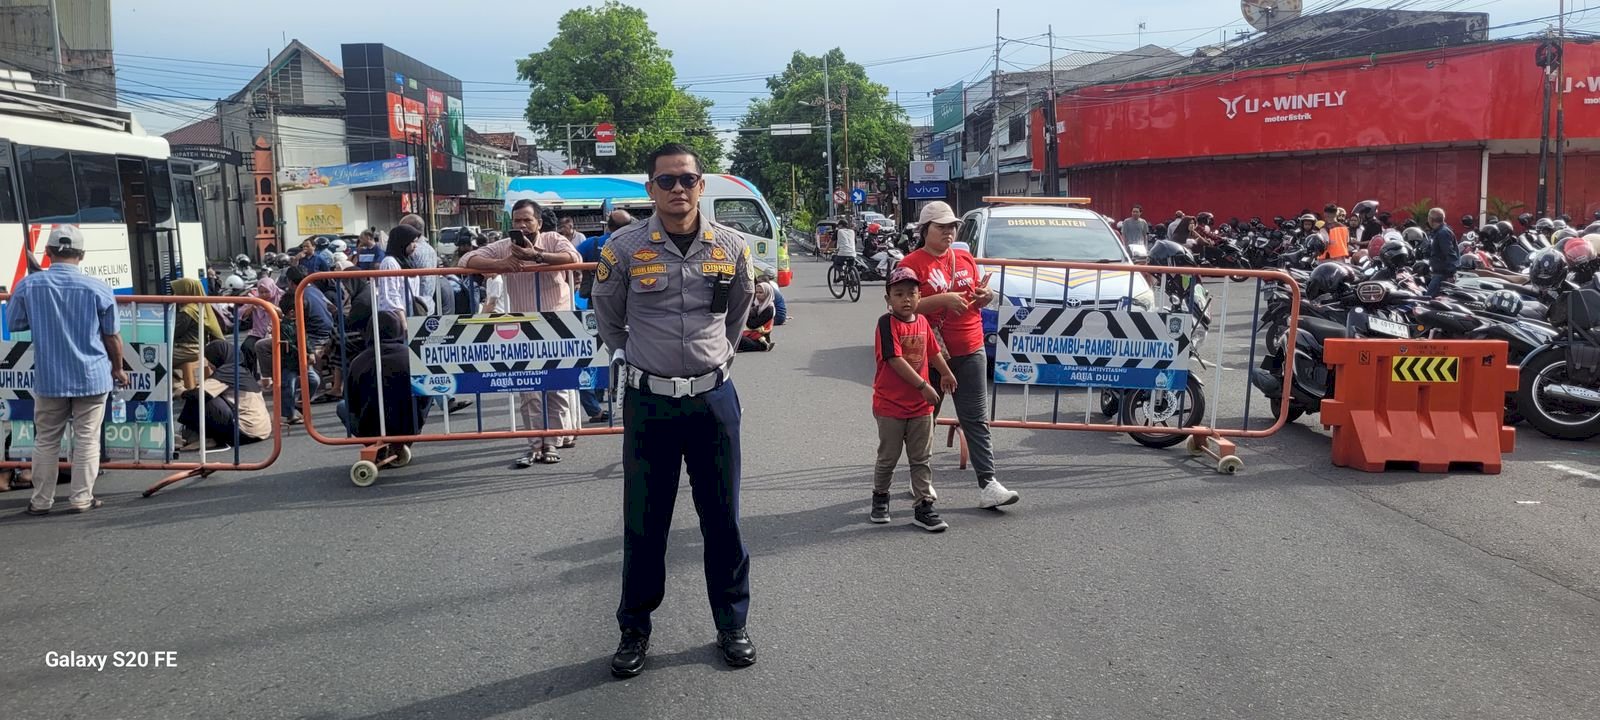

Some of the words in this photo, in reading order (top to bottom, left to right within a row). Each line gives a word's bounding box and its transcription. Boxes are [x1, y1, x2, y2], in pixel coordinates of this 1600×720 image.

[915, 185, 940, 193] vivo
[1049, 219, 1086, 227] KLATEN
[84, 266, 97, 275] SIM
[98, 264, 128, 275] KELILING
[425, 346, 460, 363] PATUHI
[461, 341, 535, 362] RAMBU-RAMBU
[537, 341, 559, 359] LALU
[560, 340, 593, 357] LINTAS
[1012, 336, 1046, 353] PATUHI
[1047, 337, 1118, 356] RAMBU-RAMBU
[1119, 340, 1141, 357] LALU
[1142, 341, 1174, 359] LINTAS
[1012, 365, 1033, 373] AQUA
[428, 376, 451, 385] AQUA
[1070, 372, 1093, 382] AQUA
[1095, 374, 1120, 382] DULU
[490, 378, 514, 388] AQUA
[516, 378, 542, 386] DULU
